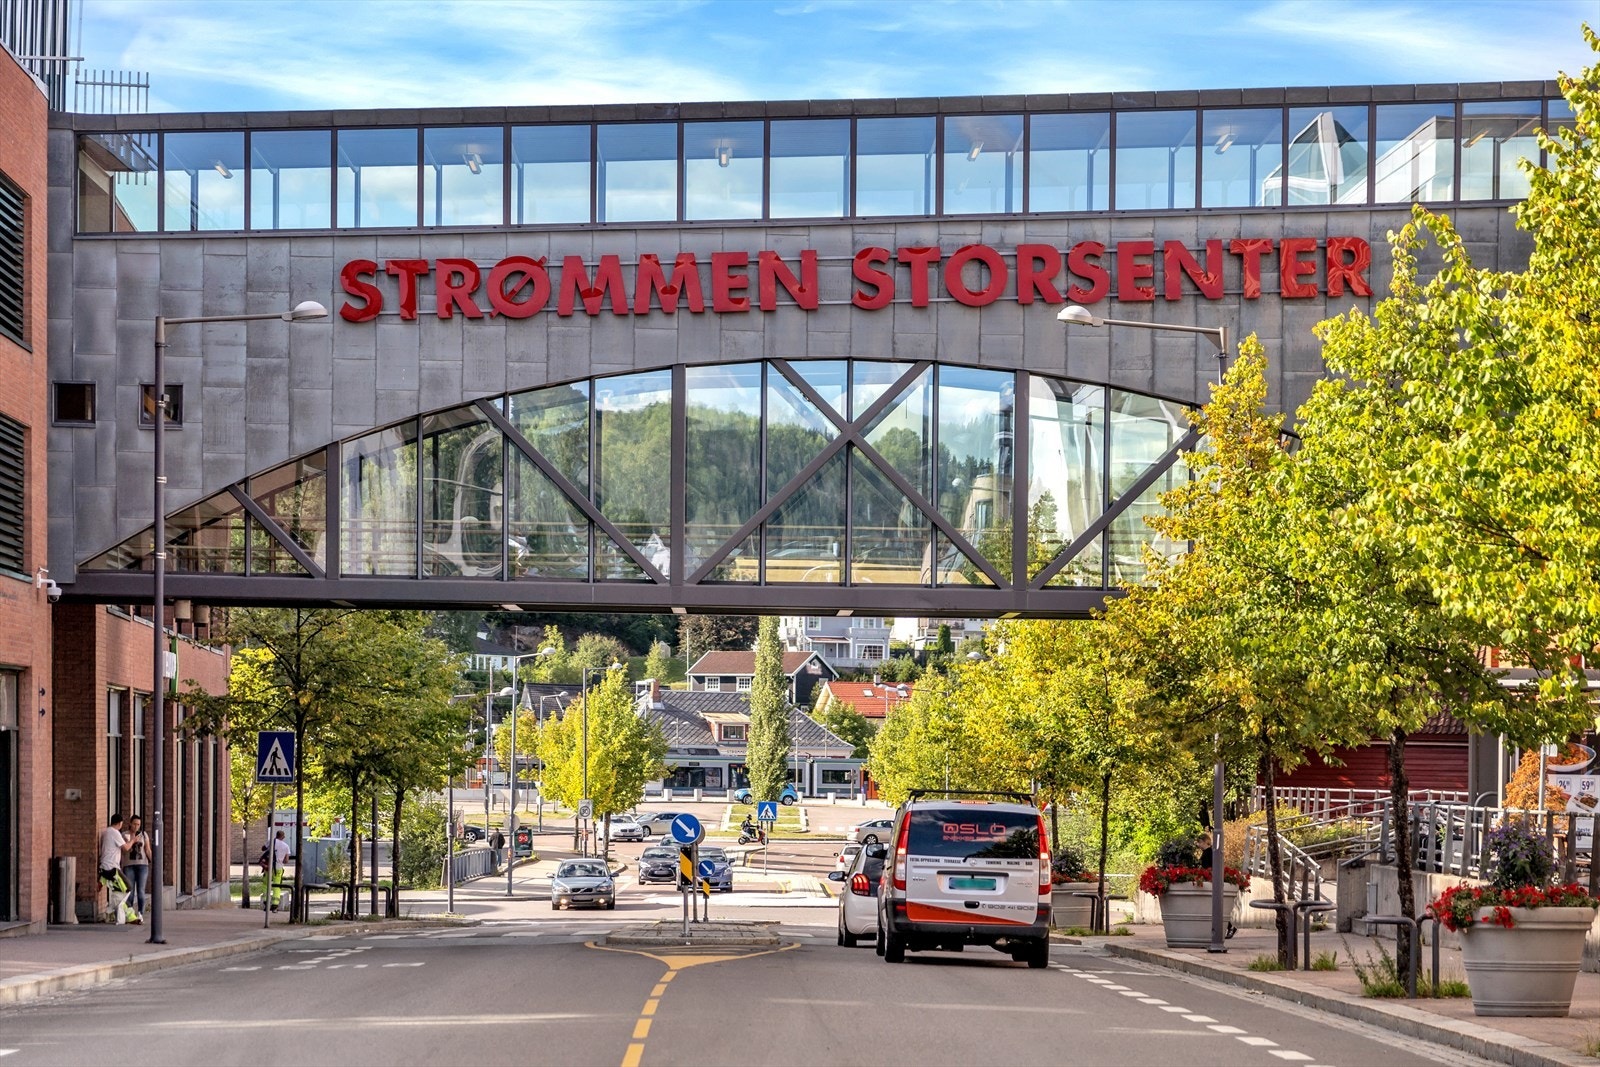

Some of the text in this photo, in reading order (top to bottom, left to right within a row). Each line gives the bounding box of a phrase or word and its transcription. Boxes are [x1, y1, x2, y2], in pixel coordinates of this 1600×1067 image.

[340, 237, 1373, 322] STRØMMEN STORSENTER
[943, 823, 1006, 835] OSLO
